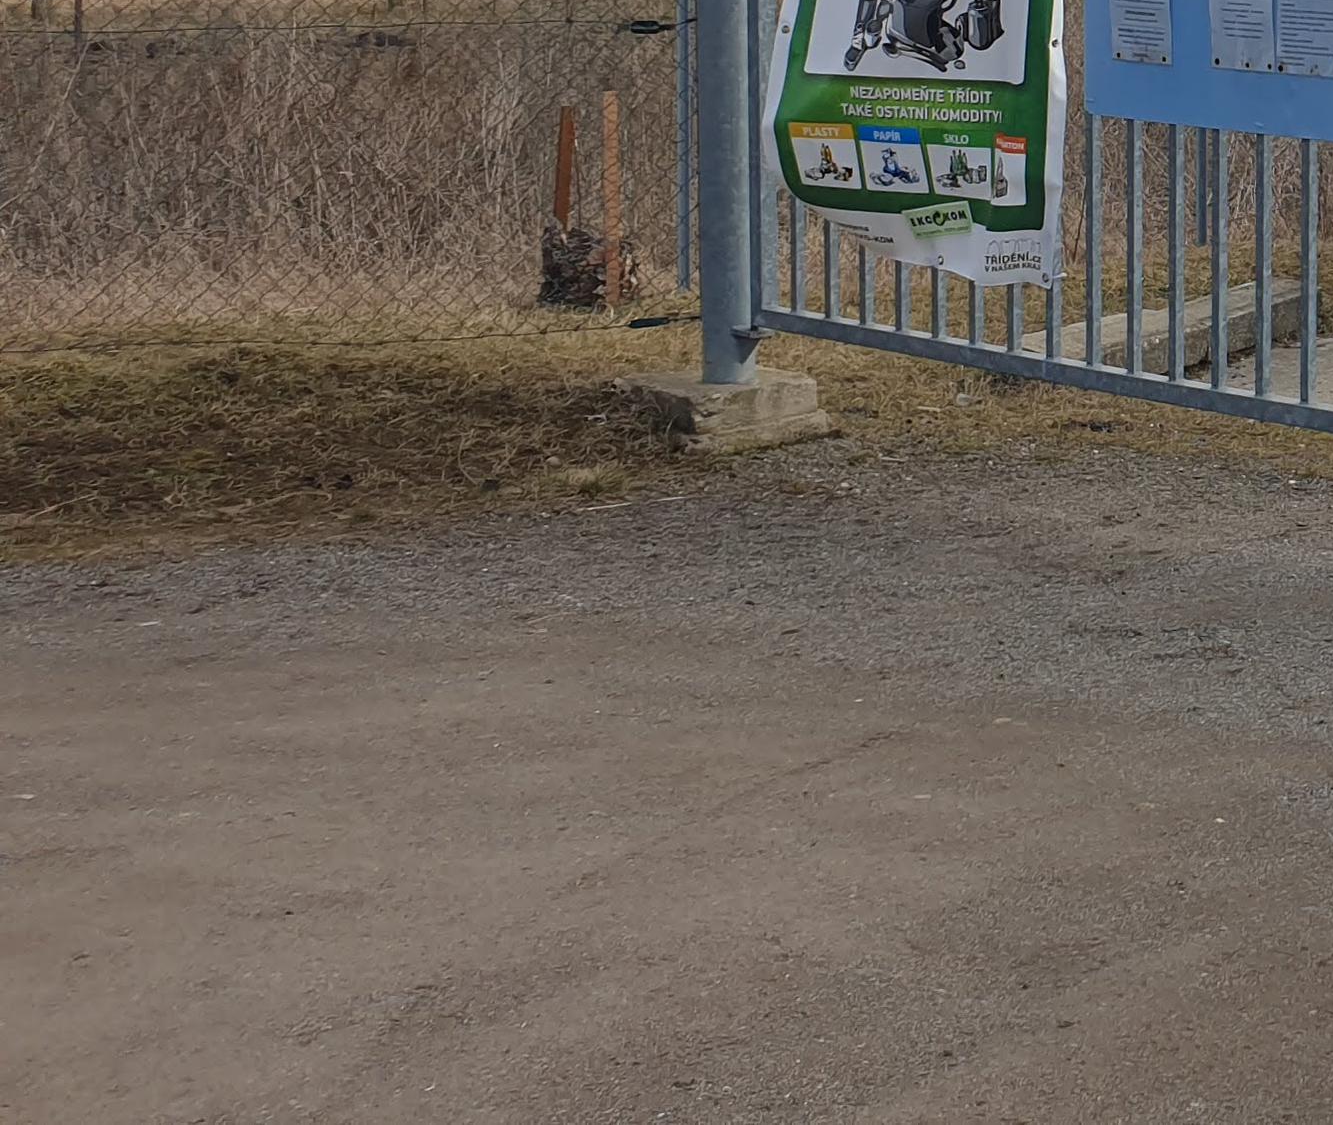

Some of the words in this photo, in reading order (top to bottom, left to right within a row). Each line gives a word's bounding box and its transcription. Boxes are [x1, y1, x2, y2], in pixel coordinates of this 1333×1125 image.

[850, 85, 945, 102] NEZAPOMEŇTE
[948, 87, 993, 104] TŘÍDIT
[841, 102, 873, 117] TAKÉ
[875, 104, 929, 120] OSTATNÍ
[803, 127, 840, 137] PLASTY
[873, 130, 901, 141] PAPÍR
[943, 133, 970, 144] SKLO
